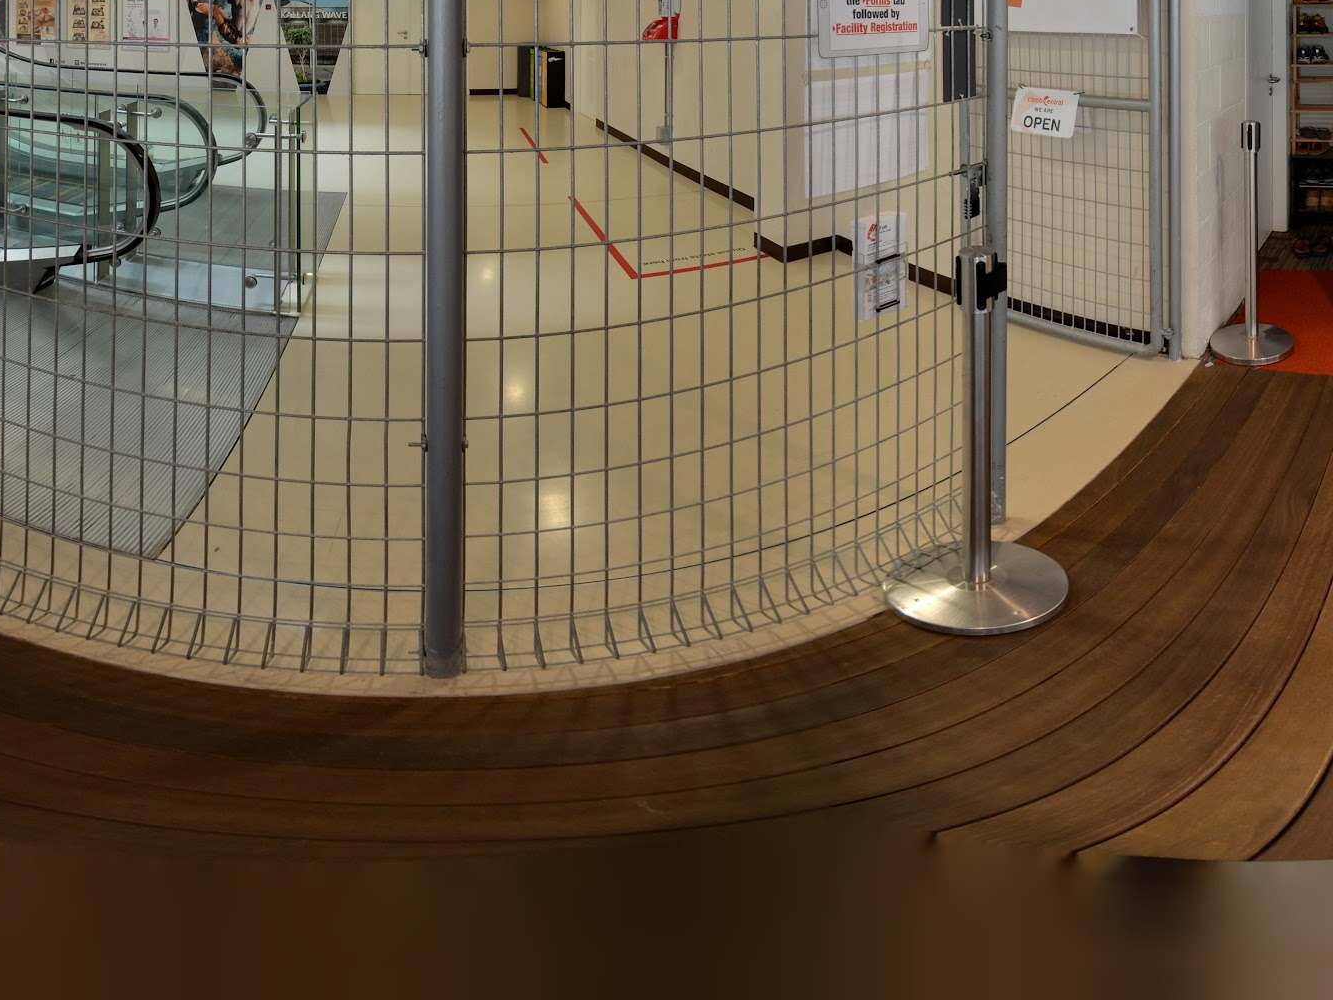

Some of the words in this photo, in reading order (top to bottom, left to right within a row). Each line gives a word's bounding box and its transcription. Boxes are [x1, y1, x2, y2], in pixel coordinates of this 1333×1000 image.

[322, 11, 348, 19] WAVE
[852, 9, 889, 19] followed
[891, 9, 900, 20] by
[836, 22, 868, 34] Facility
[870, 21, 918, 34] Registration
[1023, 115, 1061, 132] OPEN
[717, 247, 746, 255] Quue
